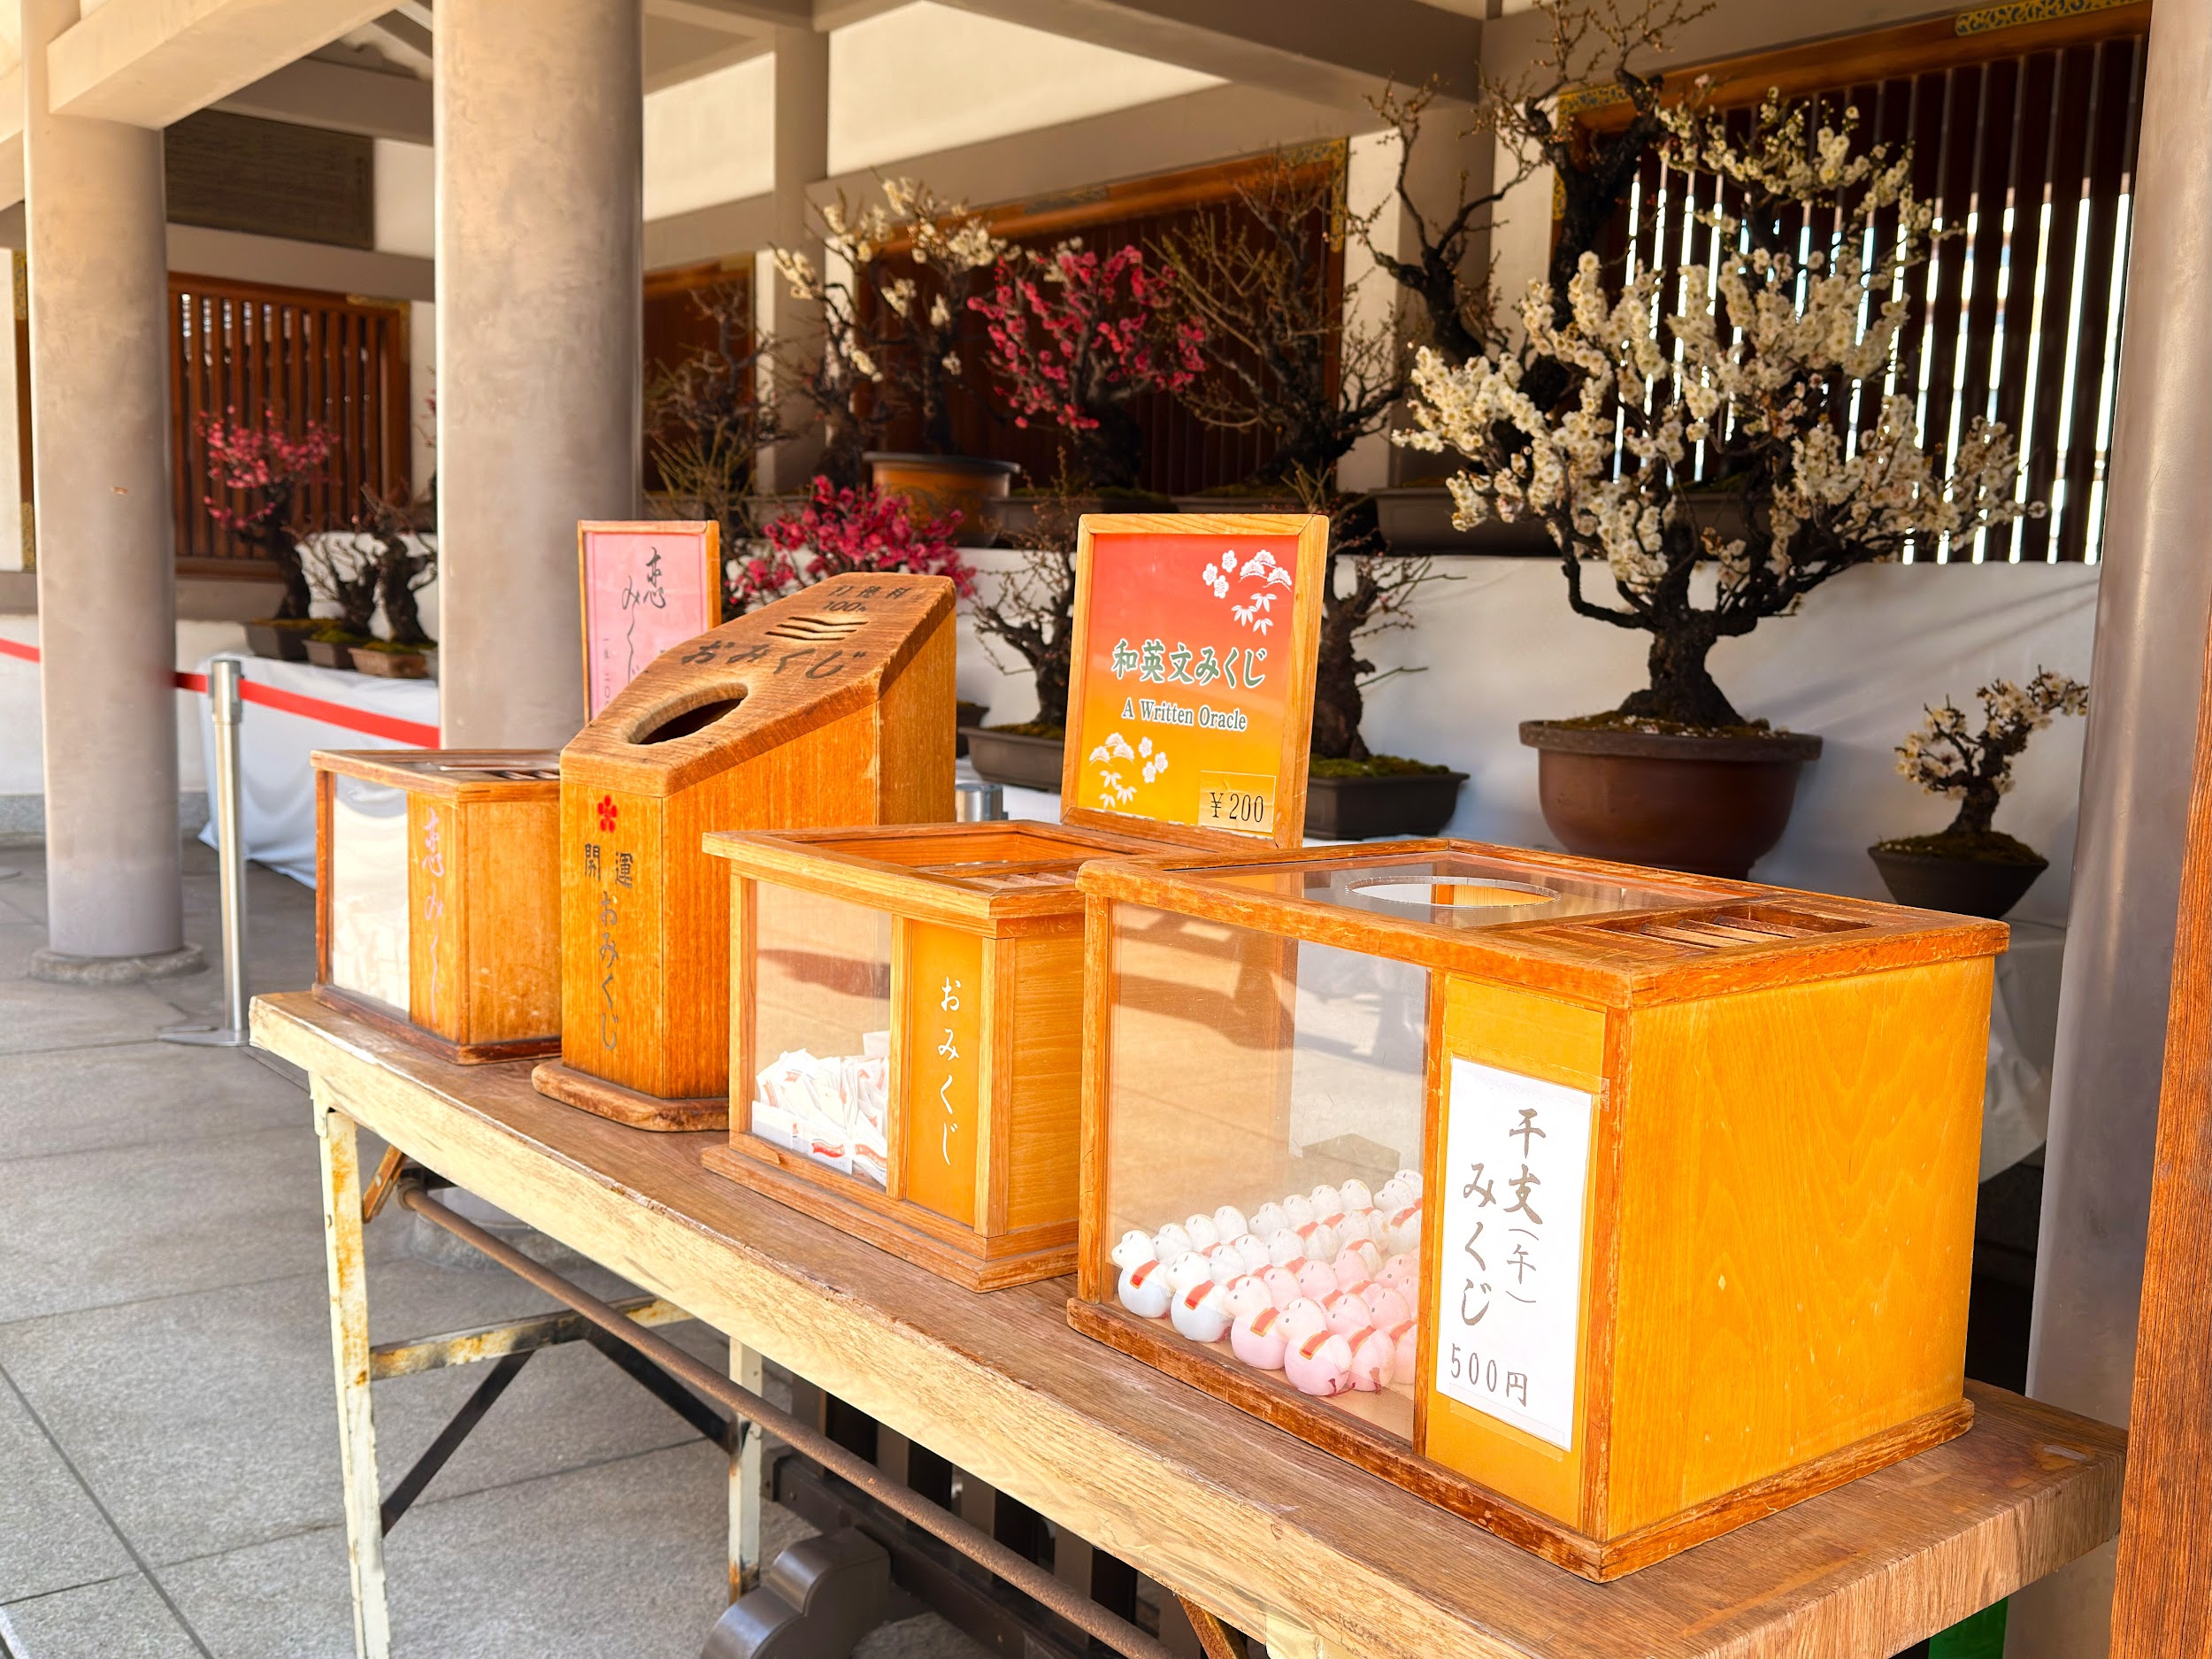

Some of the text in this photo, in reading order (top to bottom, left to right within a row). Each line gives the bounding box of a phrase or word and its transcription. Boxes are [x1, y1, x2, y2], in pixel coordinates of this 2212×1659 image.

[642, 546, 667, 610] 恋
[680, 640, 867, 680] おみくじ
[1111, 638, 1267, 689] 和英文みくじ
[1122, 697, 1248, 732] A Written Oracle
[1210, 791, 1264, 824] ¥200
[598, 890, 619, 1051] おみくじ
[937, 976, 962, 1166] おみくじ
[1462, 1163, 1497, 1326] みくじ
[1450, 1342, 1528, 1408] 500円
